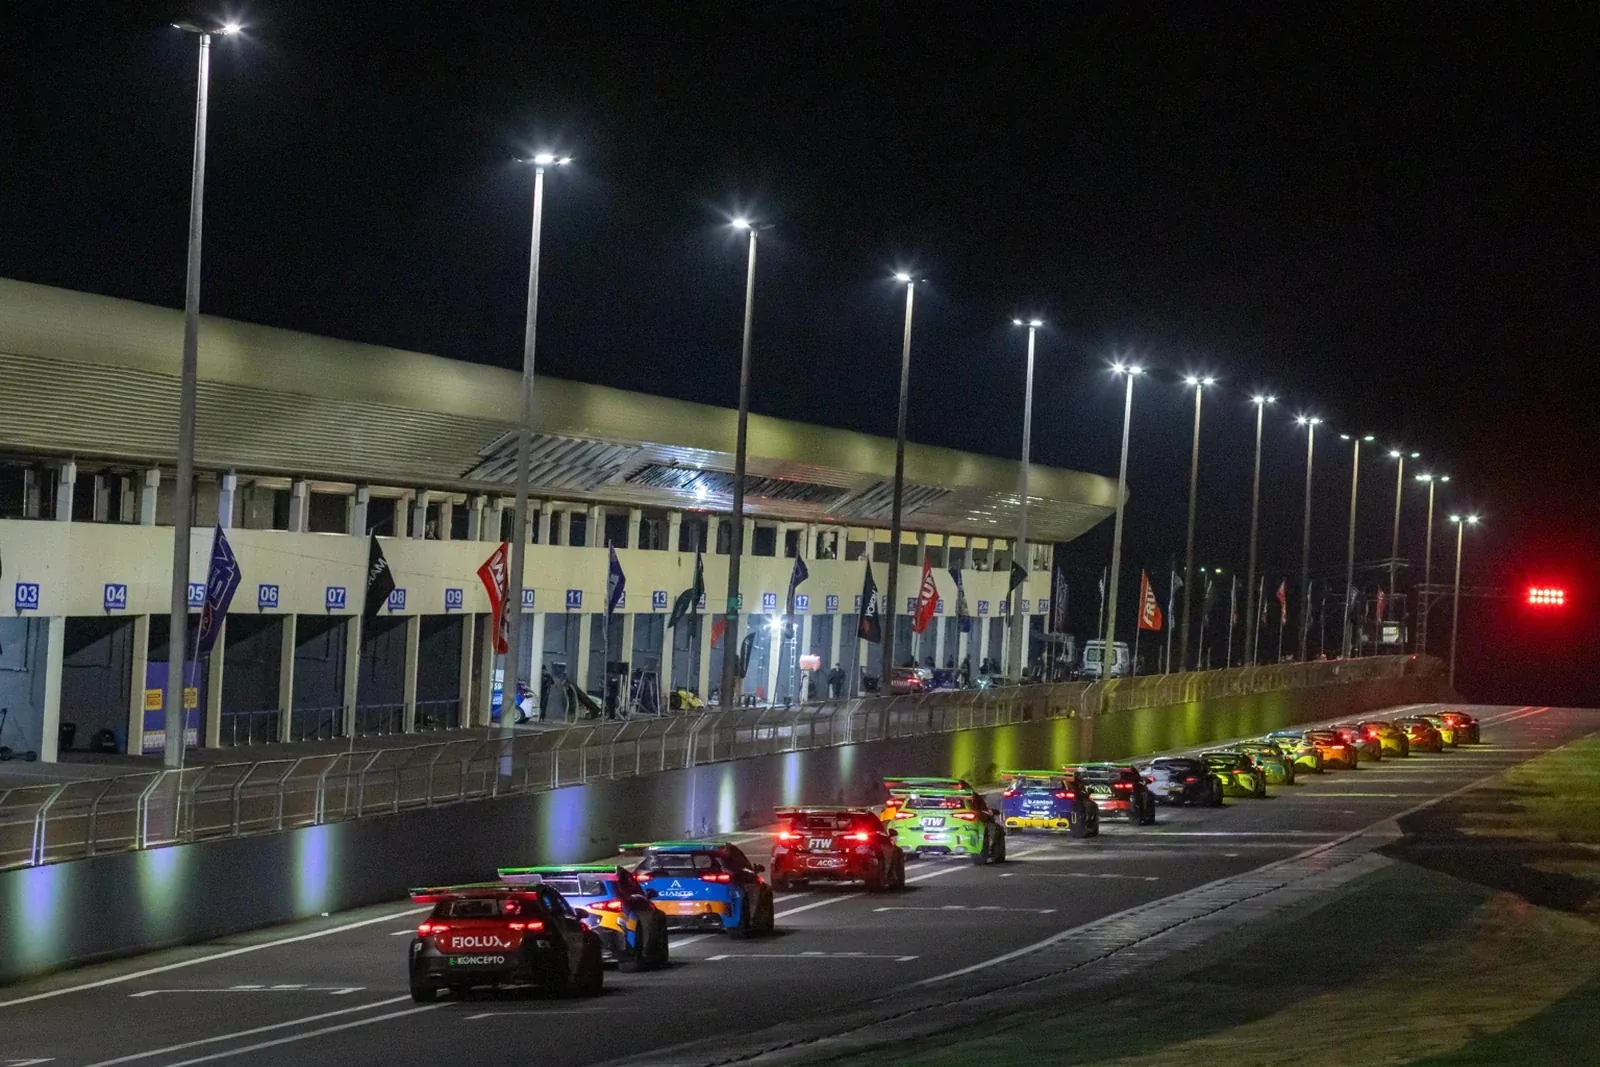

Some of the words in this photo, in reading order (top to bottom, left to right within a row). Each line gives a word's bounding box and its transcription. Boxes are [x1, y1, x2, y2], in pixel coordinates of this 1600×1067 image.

[18, 585, 37, 602] 03
[106, 586, 125, 602] 04
[188, 586, 204, 600] 05
[260, 586, 277, 601] 06
[328, 588, 344, 602] 07
[390, 590, 404, 603] 08
[447, 591, 461, 603] 09
[522, 591, 533, 603] 10
[568, 592, 581, 603] 11
[654, 592, 666, 603] 13
[764, 594, 775, 605] 16
[797, 596, 808, 606] 17
[827, 596, 838, 606] 18
[979, 601, 988, 609] 24
[1040, 600, 1049, 608] 27
[921, 817, 943, 826] FTW
[808, 838, 832, 849] FTW
